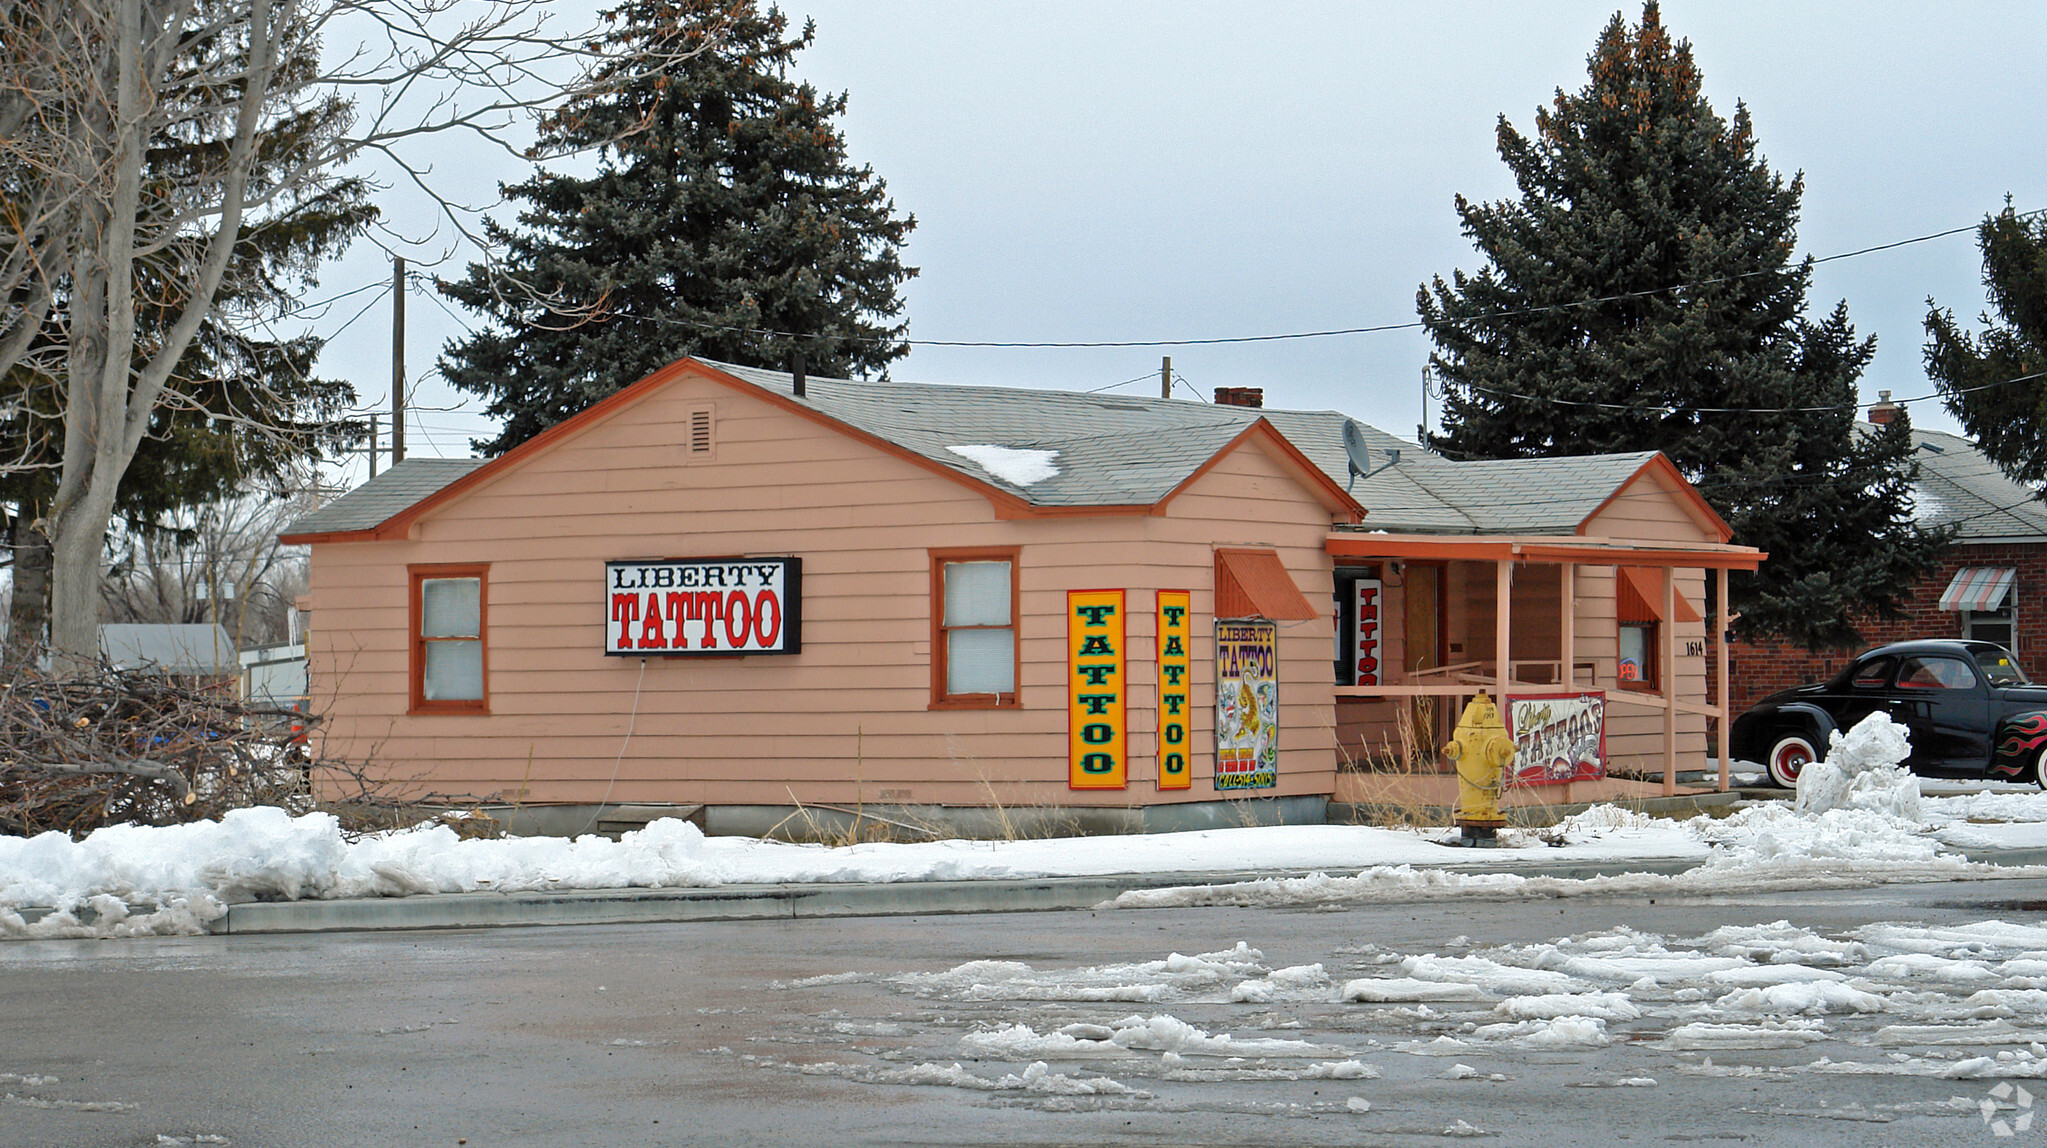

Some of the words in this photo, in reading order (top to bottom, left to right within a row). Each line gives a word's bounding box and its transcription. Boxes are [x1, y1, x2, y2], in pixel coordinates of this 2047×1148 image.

[613, 565, 780, 588] LIBERTY
[612, 589, 781, 649] TATTOO
[1218, 627, 1273, 642] LIBERTY
[1686, 641, 1703, 656] 1614
[1219, 645, 1274, 678] TATTOO
[1620, 663, 1638, 680] PEN
[1076, 605, 1117, 774] TATTOO
[1163, 606, 1185, 774] TATTOO
